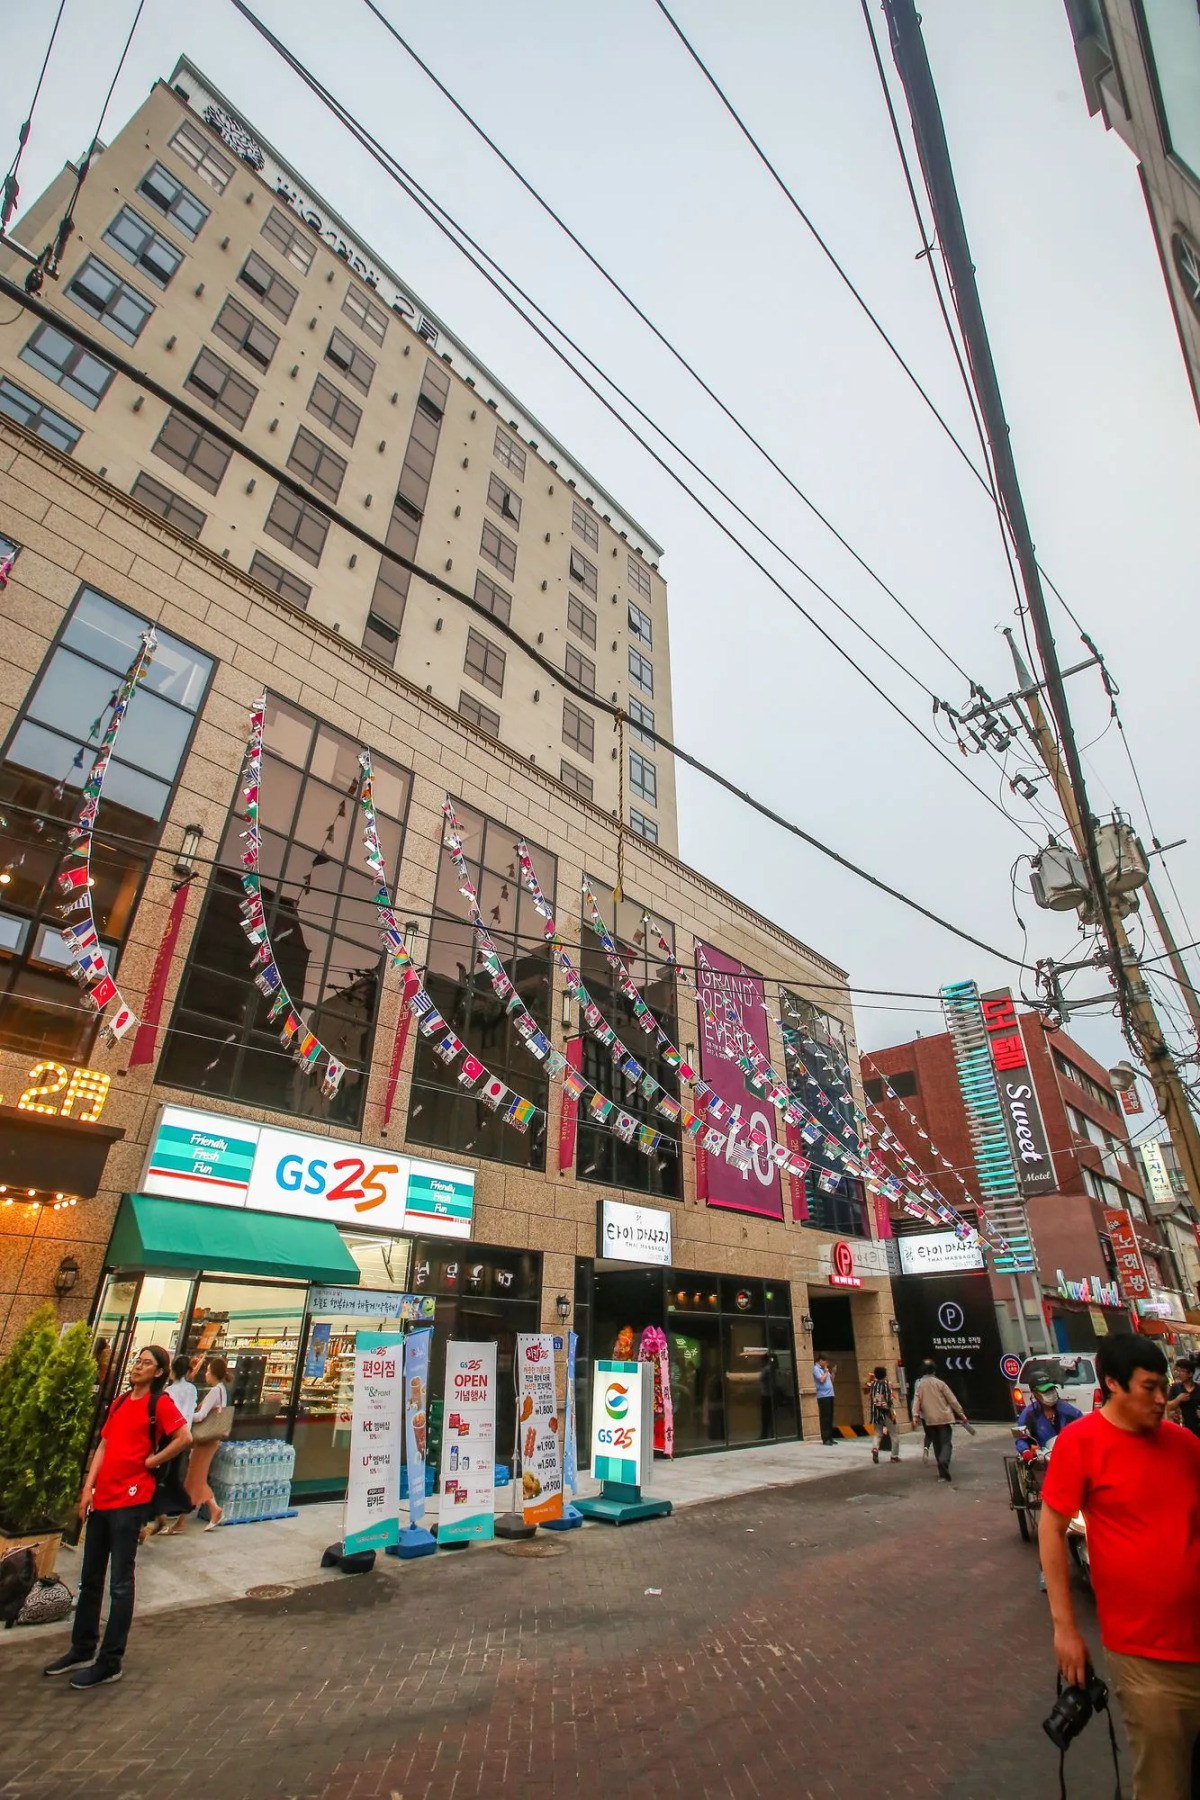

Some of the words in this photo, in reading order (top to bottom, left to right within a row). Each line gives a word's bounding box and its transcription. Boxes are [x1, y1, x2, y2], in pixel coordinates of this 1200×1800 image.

[701, 962, 752, 1007] GRAND
[702, 988, 743, 1024] OPEN
[982, 996, 1026, 1071] 모텔
[18, 1061, 111, 1122] 2月
[1006, 1083, 1044, 1164] Sweet
[189, 1133, 229, 1153] Friendly
[192, 1147, 220, 1162] Fresh
[192, 1161, 213, 1174] Fun
[276, 1154, 399, 1213] GS25
[1023, 1171, 1052, 1183] Motel
[430, 1180, 456, 1195] Friendly
[433, 1192, 452, 1203] Fresh
[434, 1203, 448, 1213] Fun
[1119, 1233, 1145, 1292] 노래방
[946, 1308, 956, 1325] P
[362, 1360, 396, 1378] 편의점
[460, 1359, 483, 1371] GS25
[454, 1374, 488, 1387] OPEN
[454, 1389, 487, 1402] 기념행사
[363, 1420, 373, 1432] kt
[598, 1427, 636, 1449] GS25
[366, 1496, 385, 1507] 팝카드
